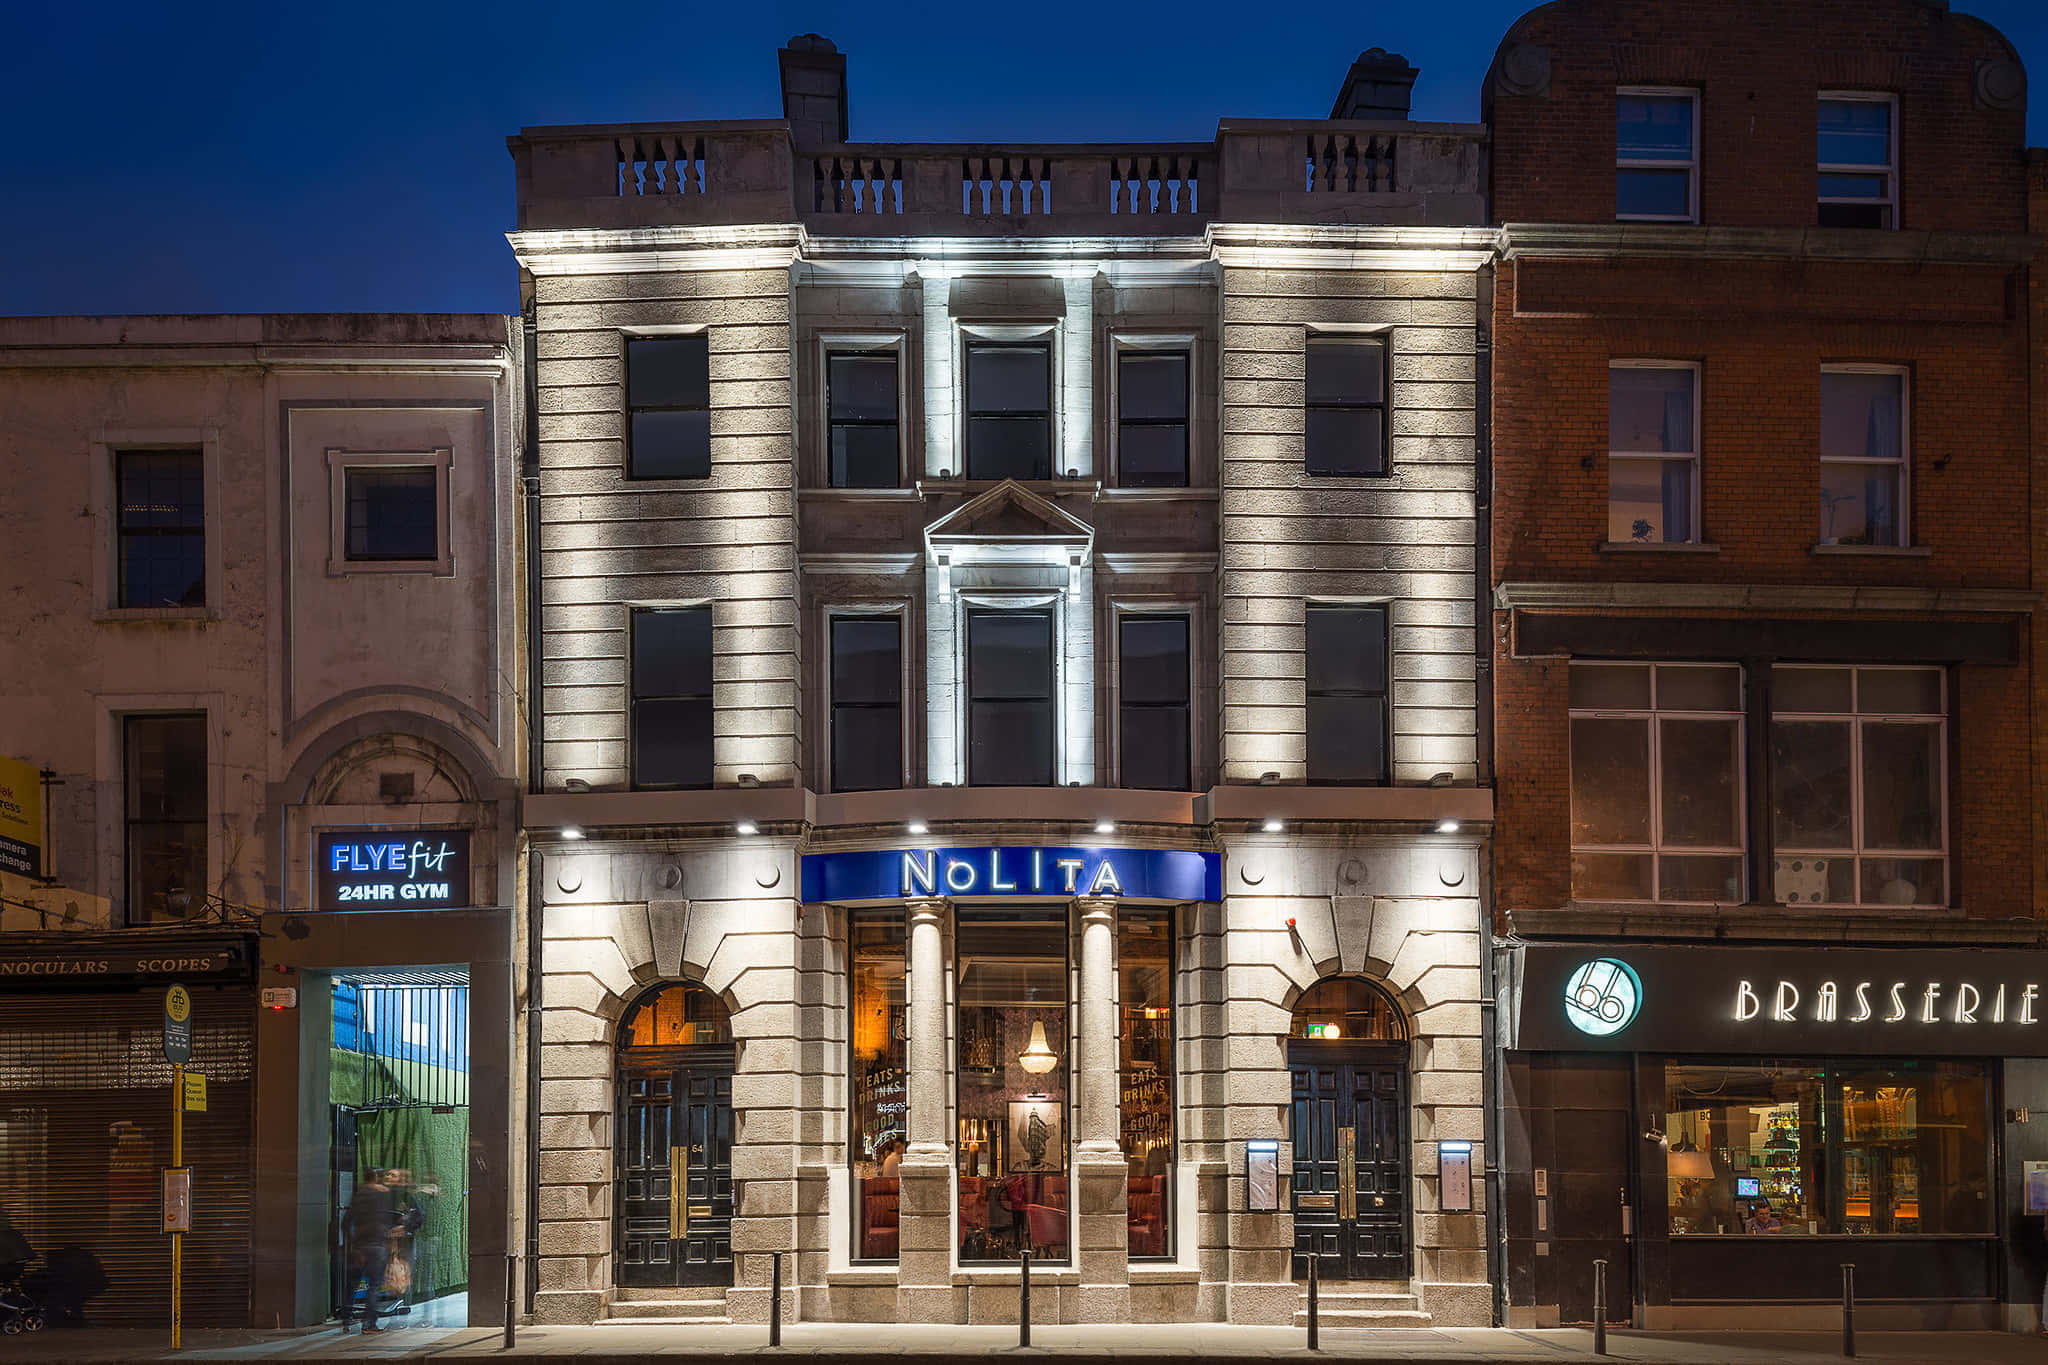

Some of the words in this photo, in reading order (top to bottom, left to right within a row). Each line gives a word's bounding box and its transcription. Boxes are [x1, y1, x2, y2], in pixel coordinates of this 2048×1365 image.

[338, 884, 395, 901] 24HR
[400, 883, 449, 900] GYM
[136, 958, 211, 973] SCOPES
[1734, 979, 2040, 1024] BRASSERIE
[866, 1067, 894, 1089] EATS
[1131, 1064, 1158, 1085] EATS
[859, 1080, 901, 1105] DRINKS
[1124, 1079, 1165, 1103] DRINKS
[691, 1144, 703, 1153] 64
